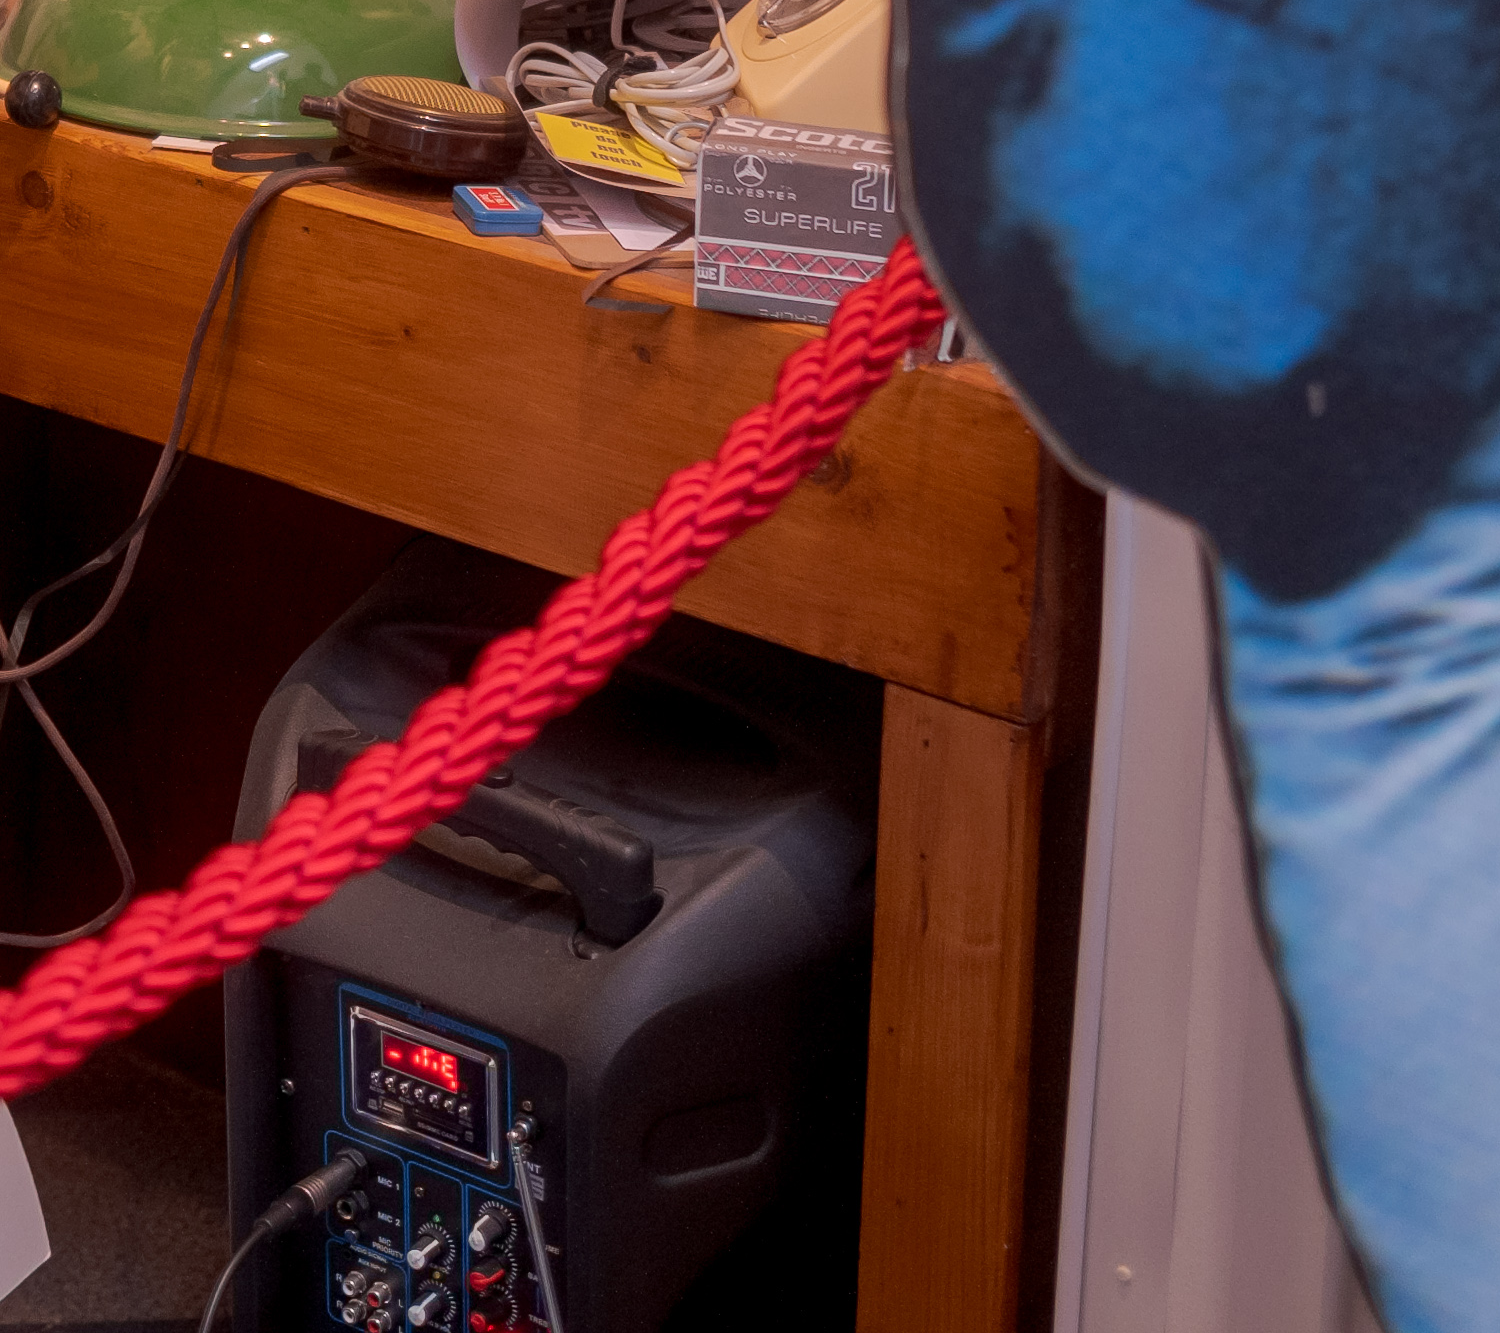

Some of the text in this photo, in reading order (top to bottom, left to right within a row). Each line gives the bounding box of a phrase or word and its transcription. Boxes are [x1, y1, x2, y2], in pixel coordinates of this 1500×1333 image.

[570, 119, 631, 141] Please
[595, 133, 619, 146] do
[590, 150, 644, 170] touch
[597, 143, 626, 158] not
[703, 183, 798, 203] POLYESTER
[744, 208, 884, 239] SUPERLIFE
